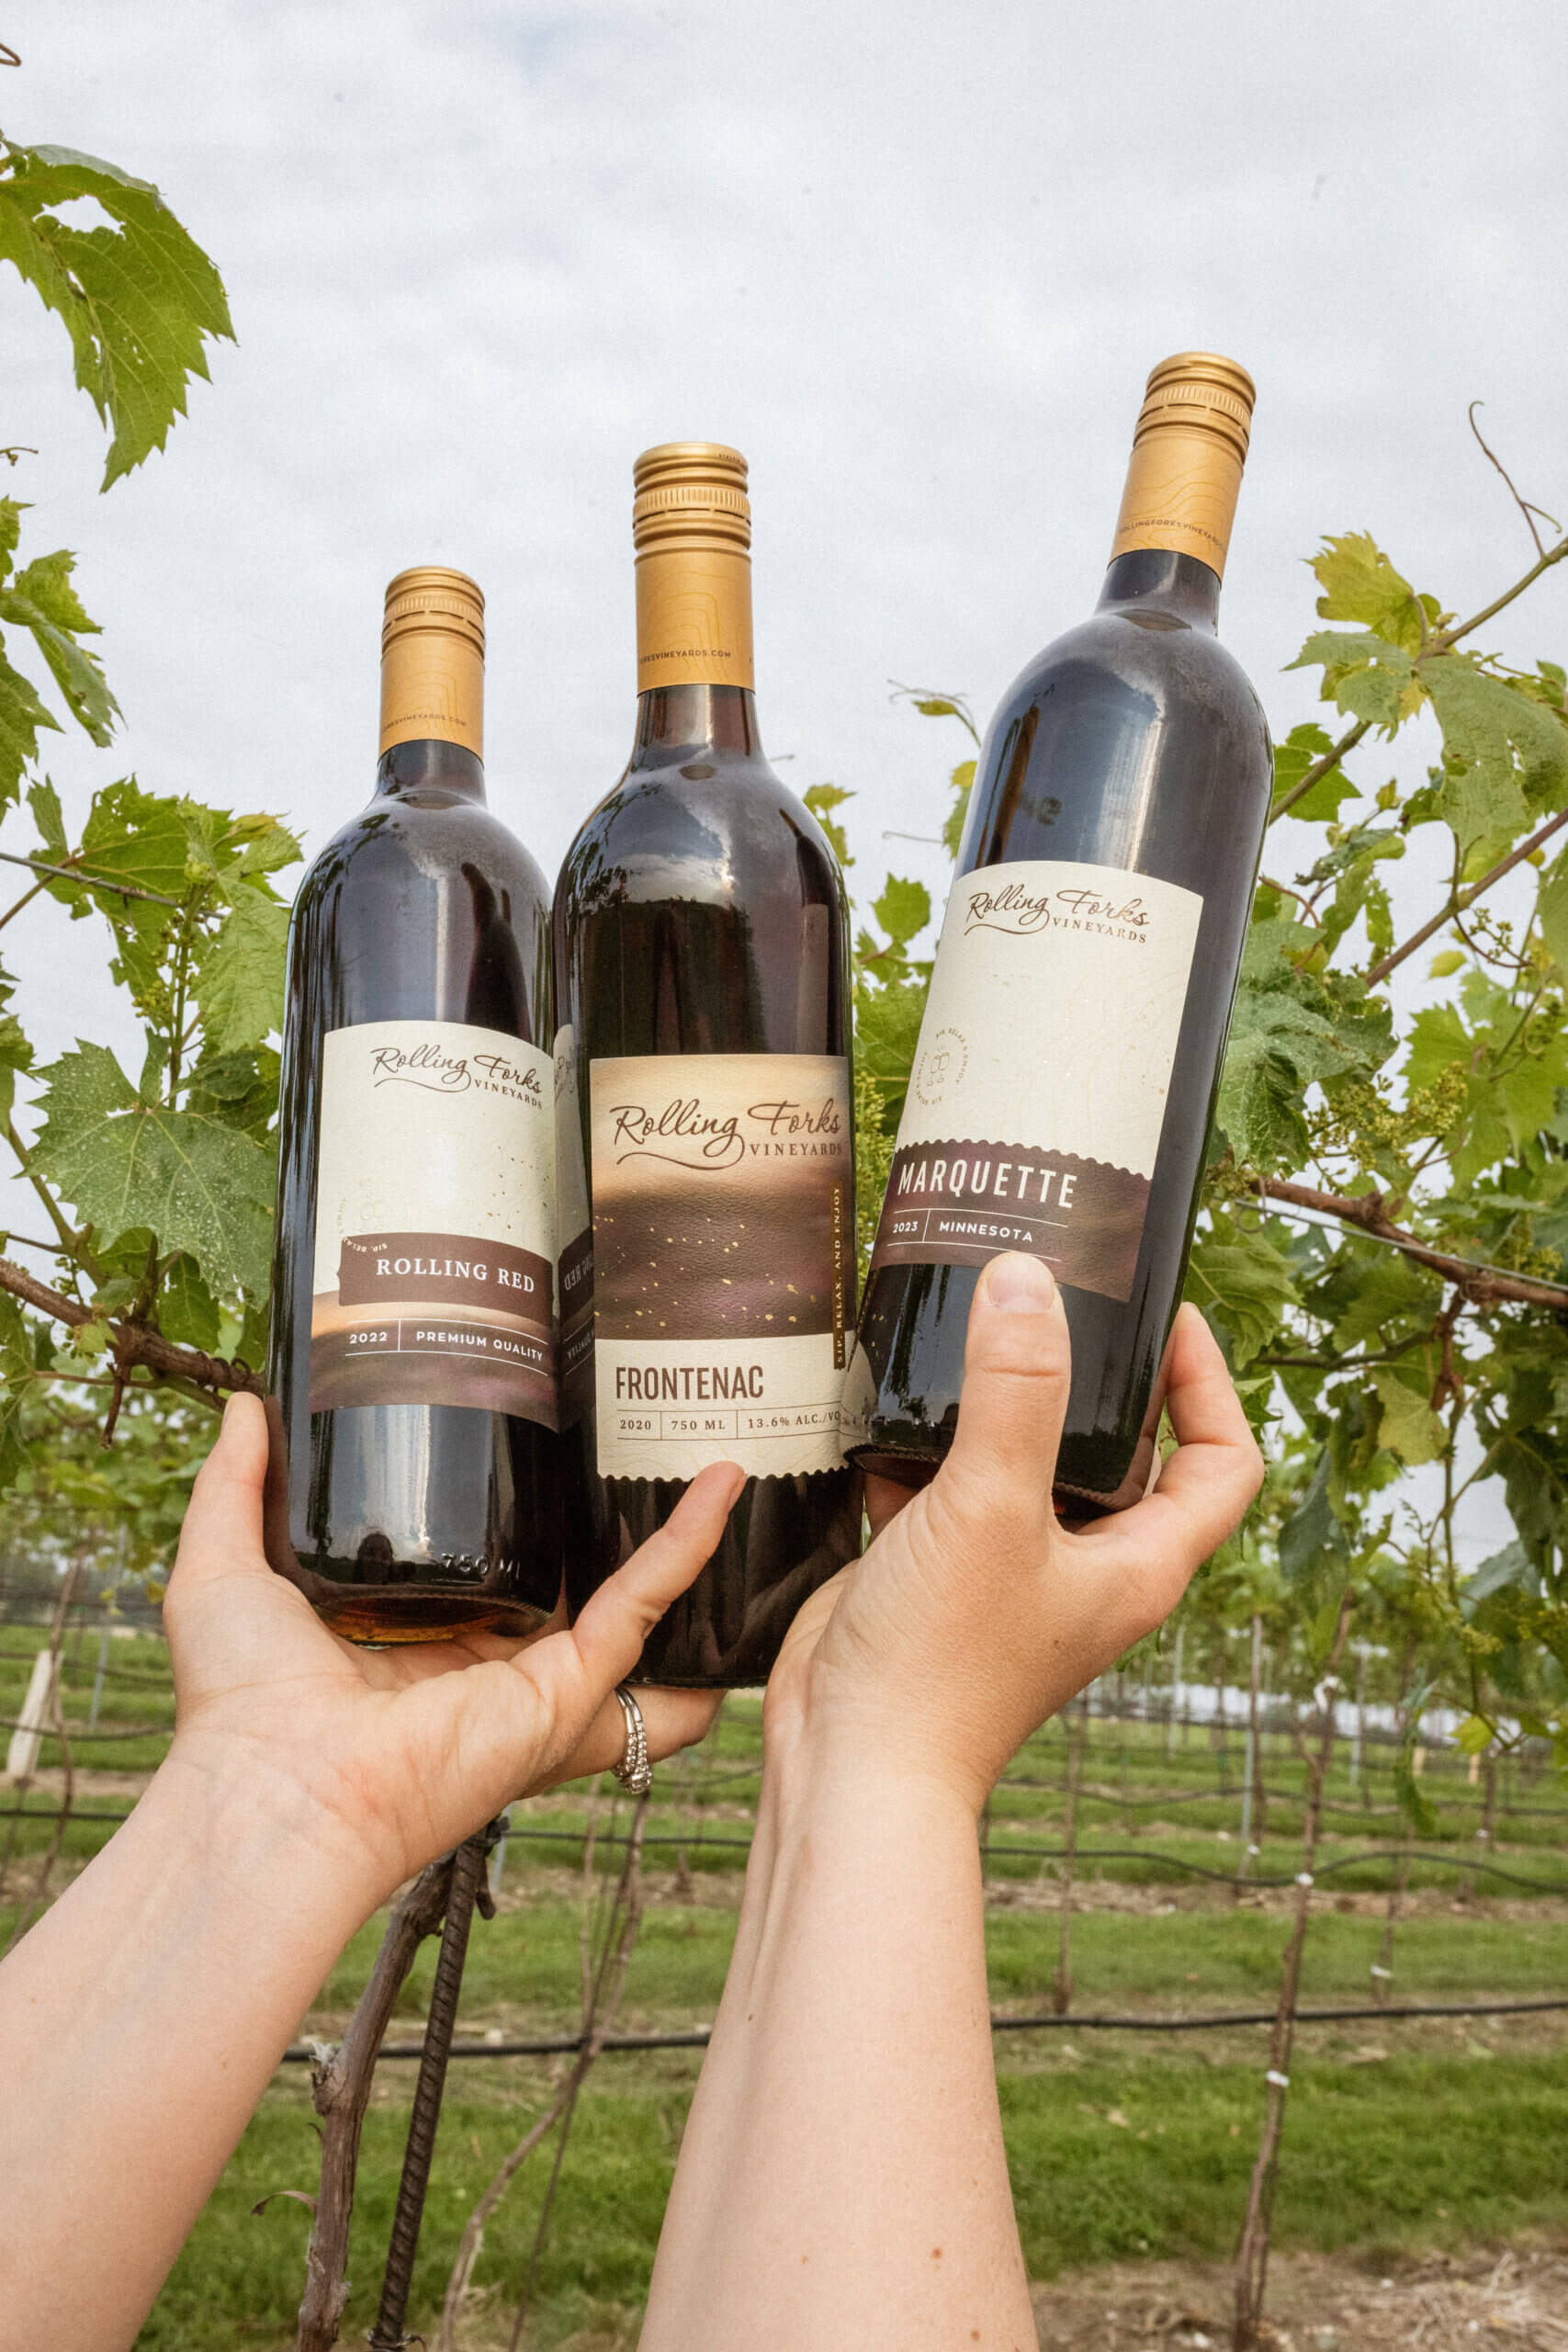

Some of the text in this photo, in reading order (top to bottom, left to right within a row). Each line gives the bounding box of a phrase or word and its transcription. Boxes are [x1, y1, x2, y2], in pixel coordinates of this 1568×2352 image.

[964, 883, 1150, 935] Rolling Forks
[1053, 917, 1147, 944] VINEYARDS
[370, 1043, 471, 1093] Rolling
[474, 1055, 543, 1094] Forks
[474, 1079, 543, 1110] VINEYARDS
[609, 1097, 840, 1170] Rolling Forks
[750, 1143, 842, 1156] VINEYARDS
[897, 1159, 1078, 1208] MARQUETTE
[892, 1221, 1033, 1242] 2023 MINNESOTA
[833, 1240, 841, 1270] AND
[376, 1257, 536, 1294] ROLLING RED
[349, 1330, 544, 1362] 2022 PREMIUM QUALITY
[615, 1364, 764, 1400] FRONTENAC
[619, 1419, 652, 1430] 2020
[671, 1420, 698, 1430] 750
[705, 1419, 726, 1430] ML
[747, 1416, 790, 1429] 13.6%
[795, 1410, 840, 1426] ALC./VO
[442, 1552, 490, 1576] 750
